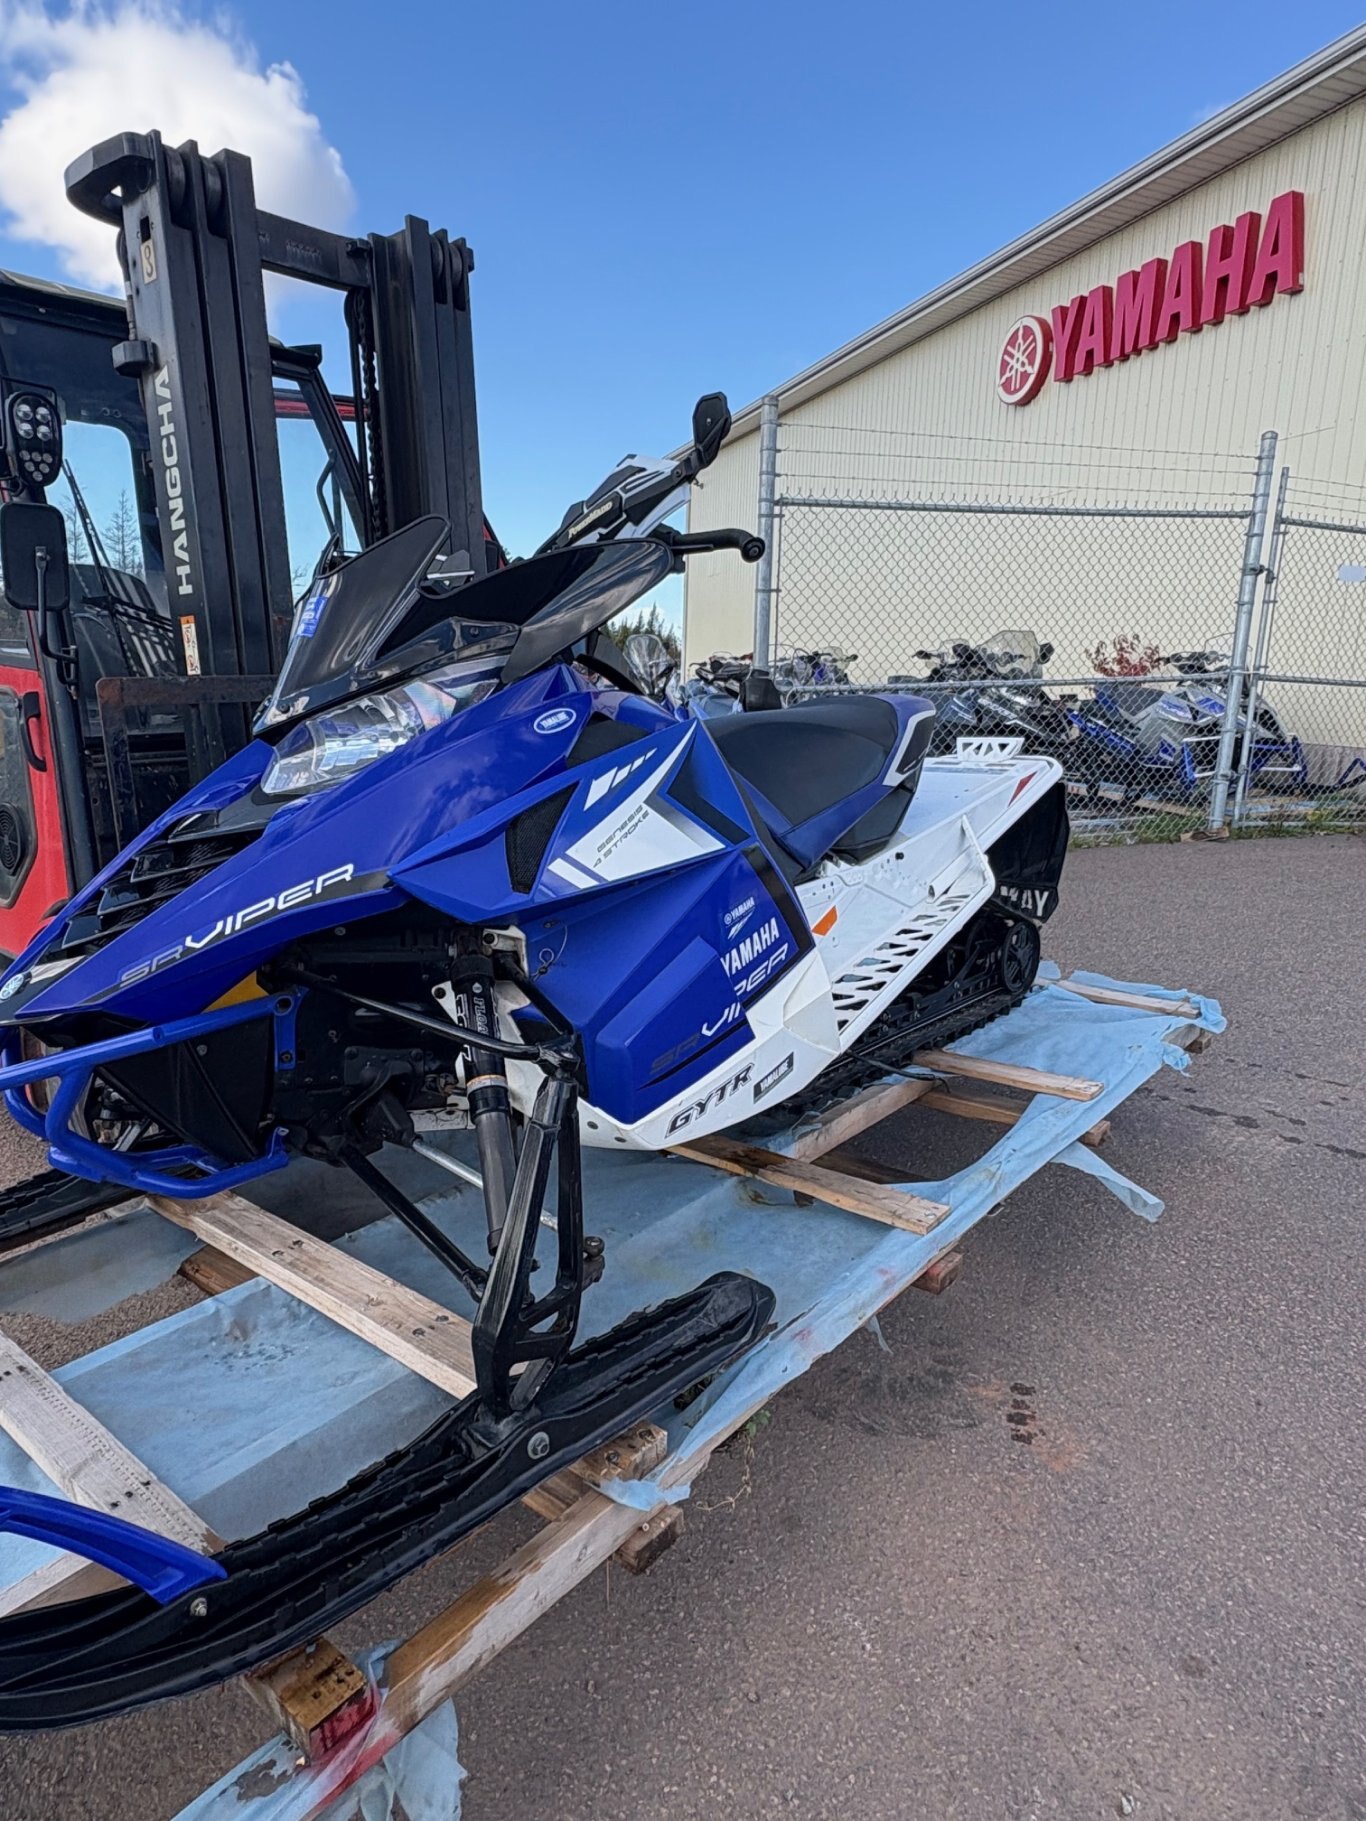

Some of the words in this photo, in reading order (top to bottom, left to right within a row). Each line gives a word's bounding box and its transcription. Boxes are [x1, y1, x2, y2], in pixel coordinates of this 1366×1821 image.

[1051, 190, 1304, 383] YAMAHA
[154, 365, 193, 596] HANGCHA
[603, 810, 650, 859] STROKE
[730, 897, 756, 920] YAMAHA
[720, 917, 780, 978] YAMAHA
[665, 1062, 755, 1138] GYTR
